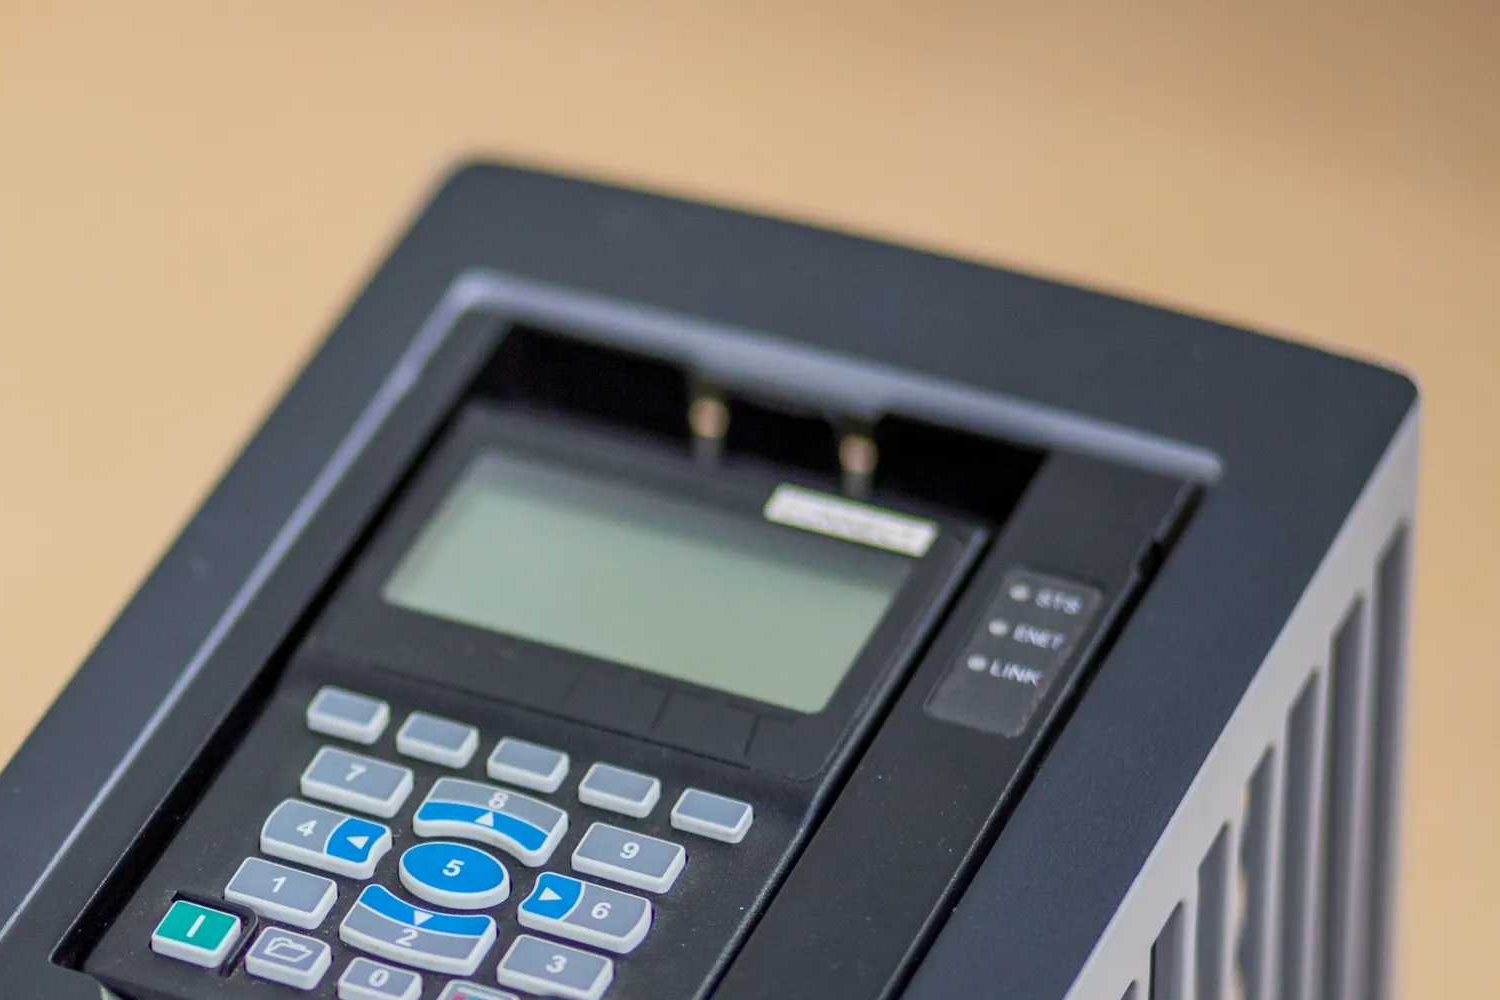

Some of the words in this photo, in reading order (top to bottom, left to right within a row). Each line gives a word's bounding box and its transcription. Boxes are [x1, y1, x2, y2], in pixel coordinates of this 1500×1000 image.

[1013, 624, 1064, 649] ENET
[990, 660, 1043, 686] LINK
[345, 762, 367, 782] 7
[488, 791, 509, 809] 8
[296, 819, 317, 837] 4
[619, 841, 640, 859] 9
[442, 858, 465, 877] 5
[272, 876, 287, 893] 1
[591, 902, 611, 920] 6
[395, 928, 418, 947] 2
[545, 954, 567, 973] 3
[368, 968, 390, 988] 0
